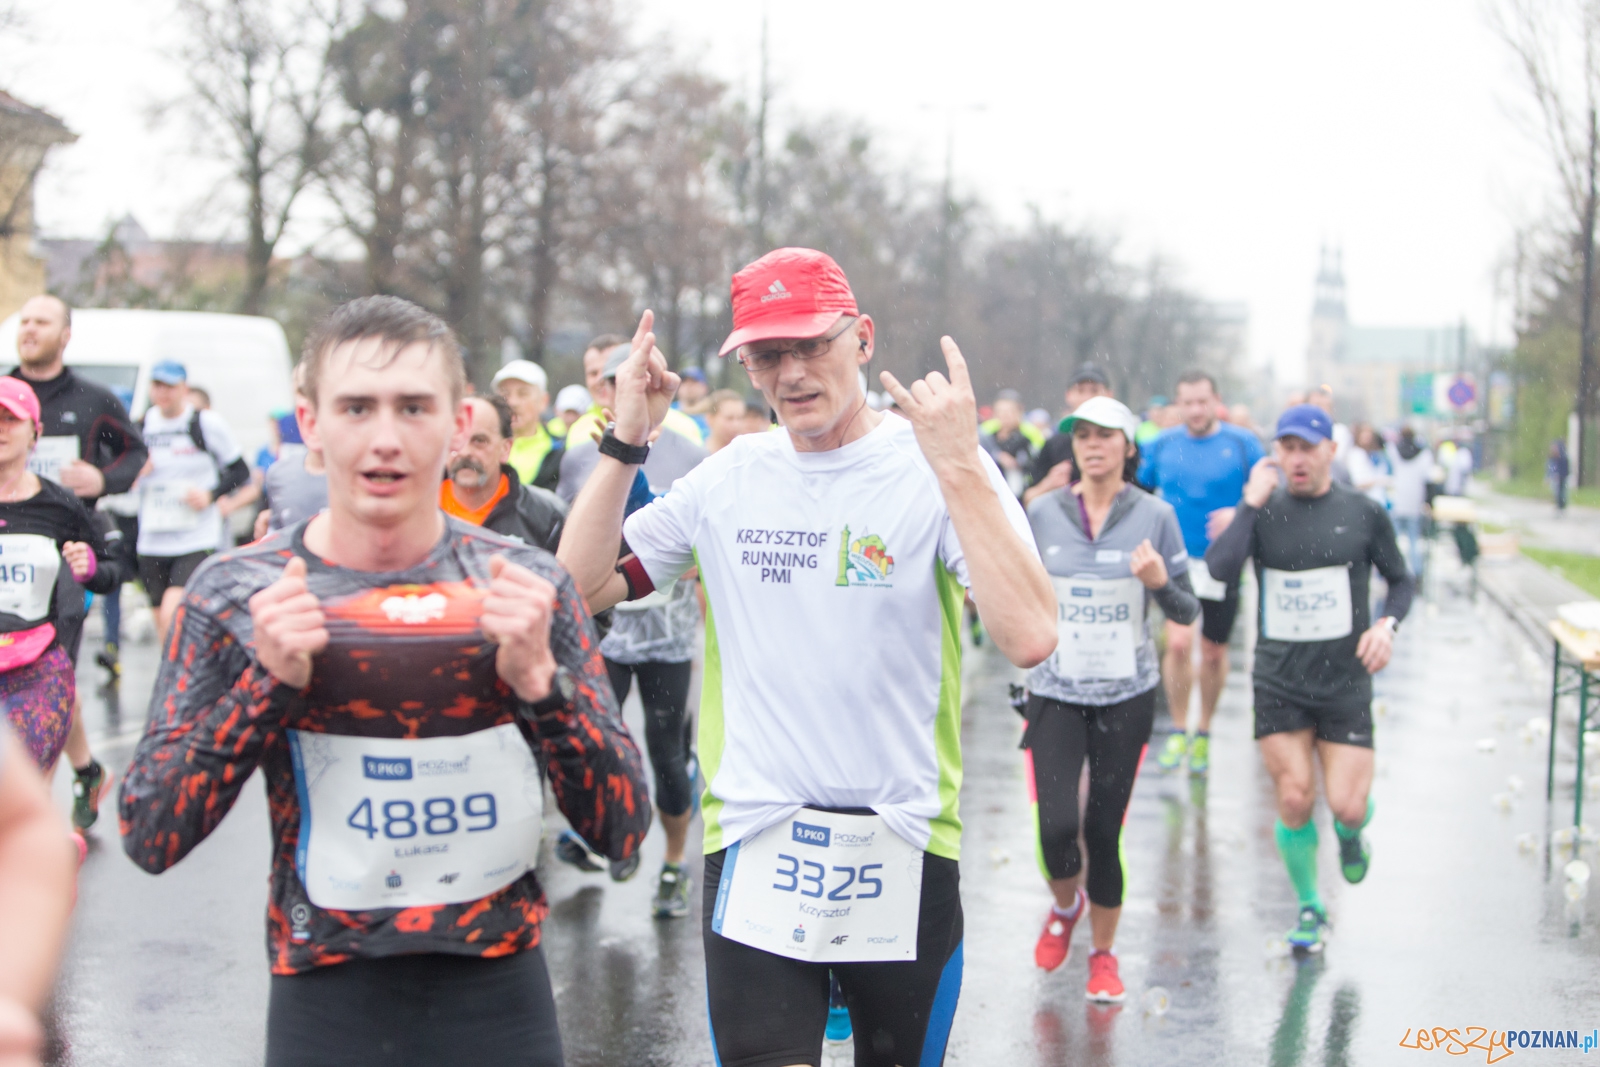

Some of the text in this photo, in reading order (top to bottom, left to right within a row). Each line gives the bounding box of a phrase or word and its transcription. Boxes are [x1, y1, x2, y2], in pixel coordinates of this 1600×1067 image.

[760, 291, 792, 303] adidas
[736, 529, 828, 547] KRZYSZTOF
[741, 551, 818, 568] RUNNING
[761, 568, 792, 583] PMI
[1275, 591, 1338, 612] 12625
[1058, 603, 1130, 624] 12958
[346, 792, 498, 840] 4889
[796, 827, 826, 842] 9.PKO
[773, 853, 883, 902] 3325
[799, 902, 851, 919] Krzysztof
[830, 935, 849, 946] 4F
